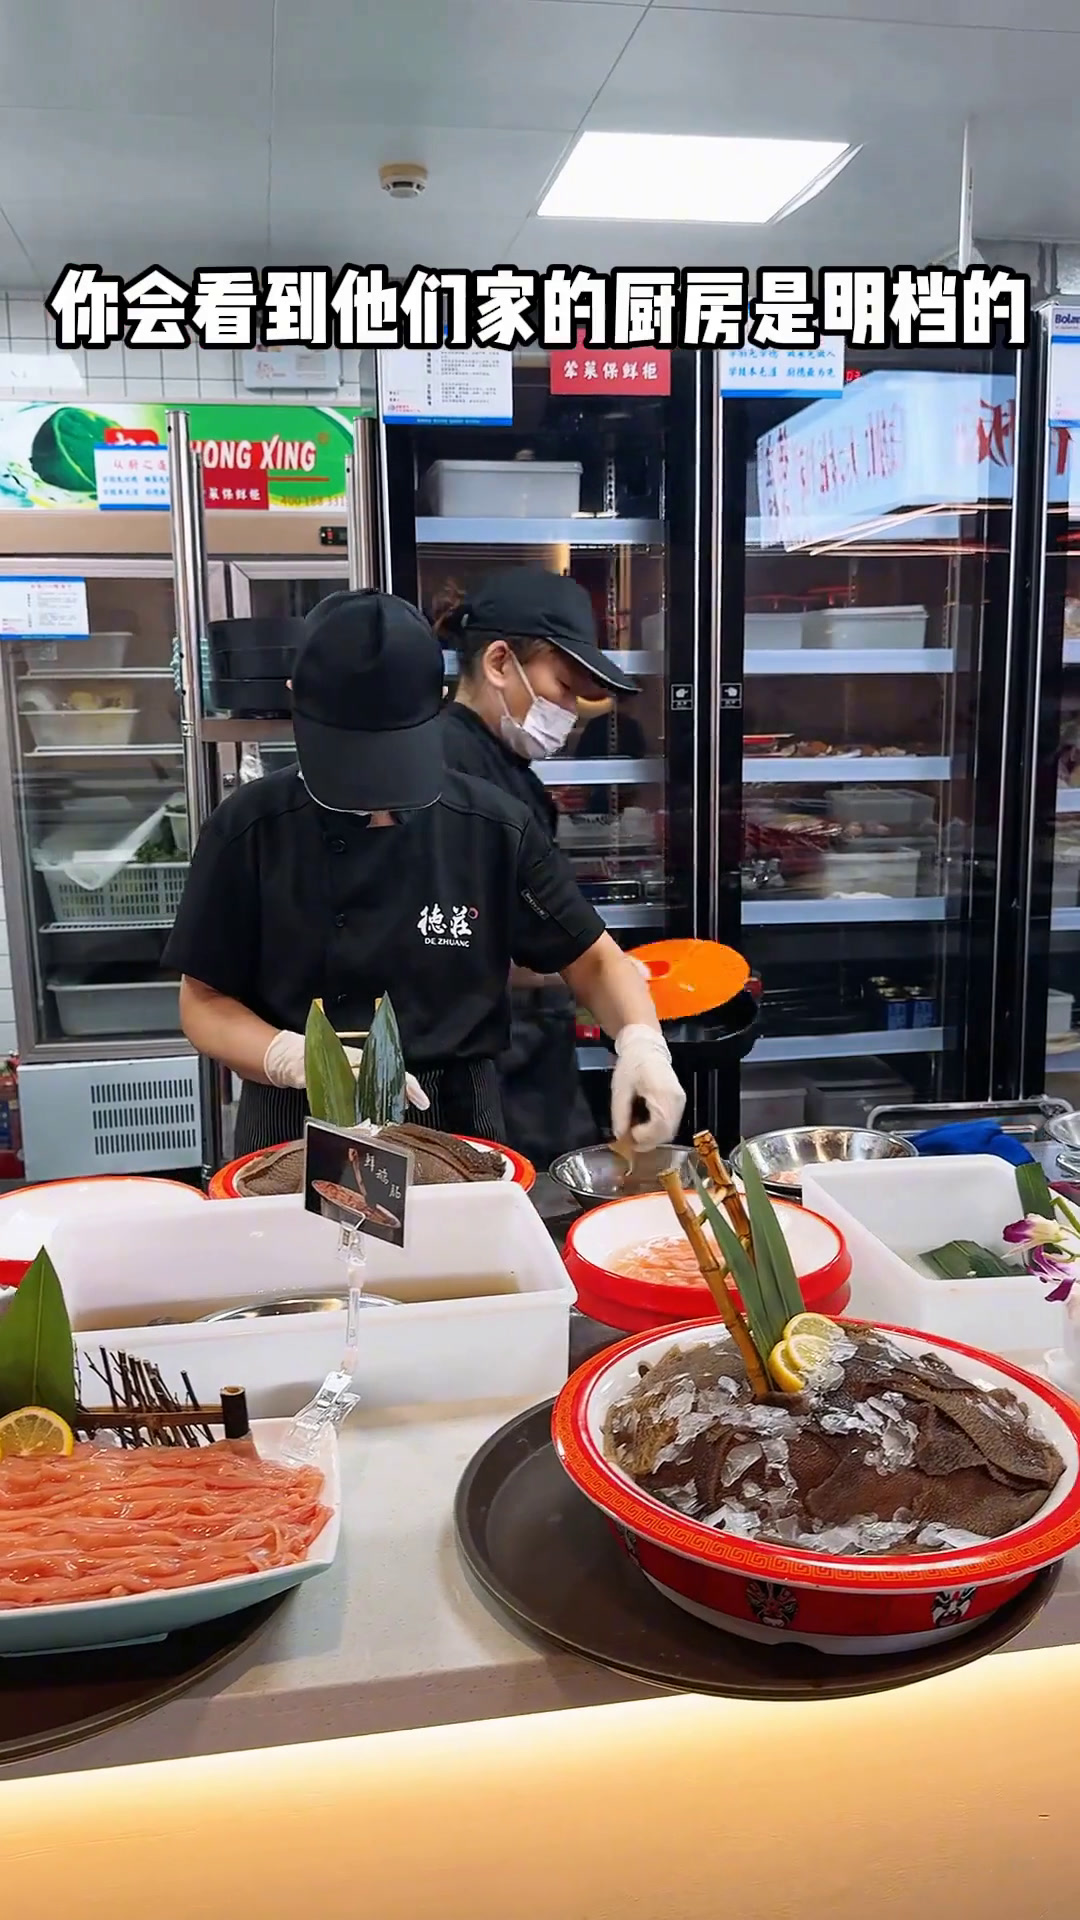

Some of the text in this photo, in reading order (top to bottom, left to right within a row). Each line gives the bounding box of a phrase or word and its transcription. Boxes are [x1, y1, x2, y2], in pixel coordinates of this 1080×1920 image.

[563, 360, 658, 380] 荤菜保鲜柜
[260, 434, 316, 472] XING
[424, 937, 470, 948] DE ZHUANG
